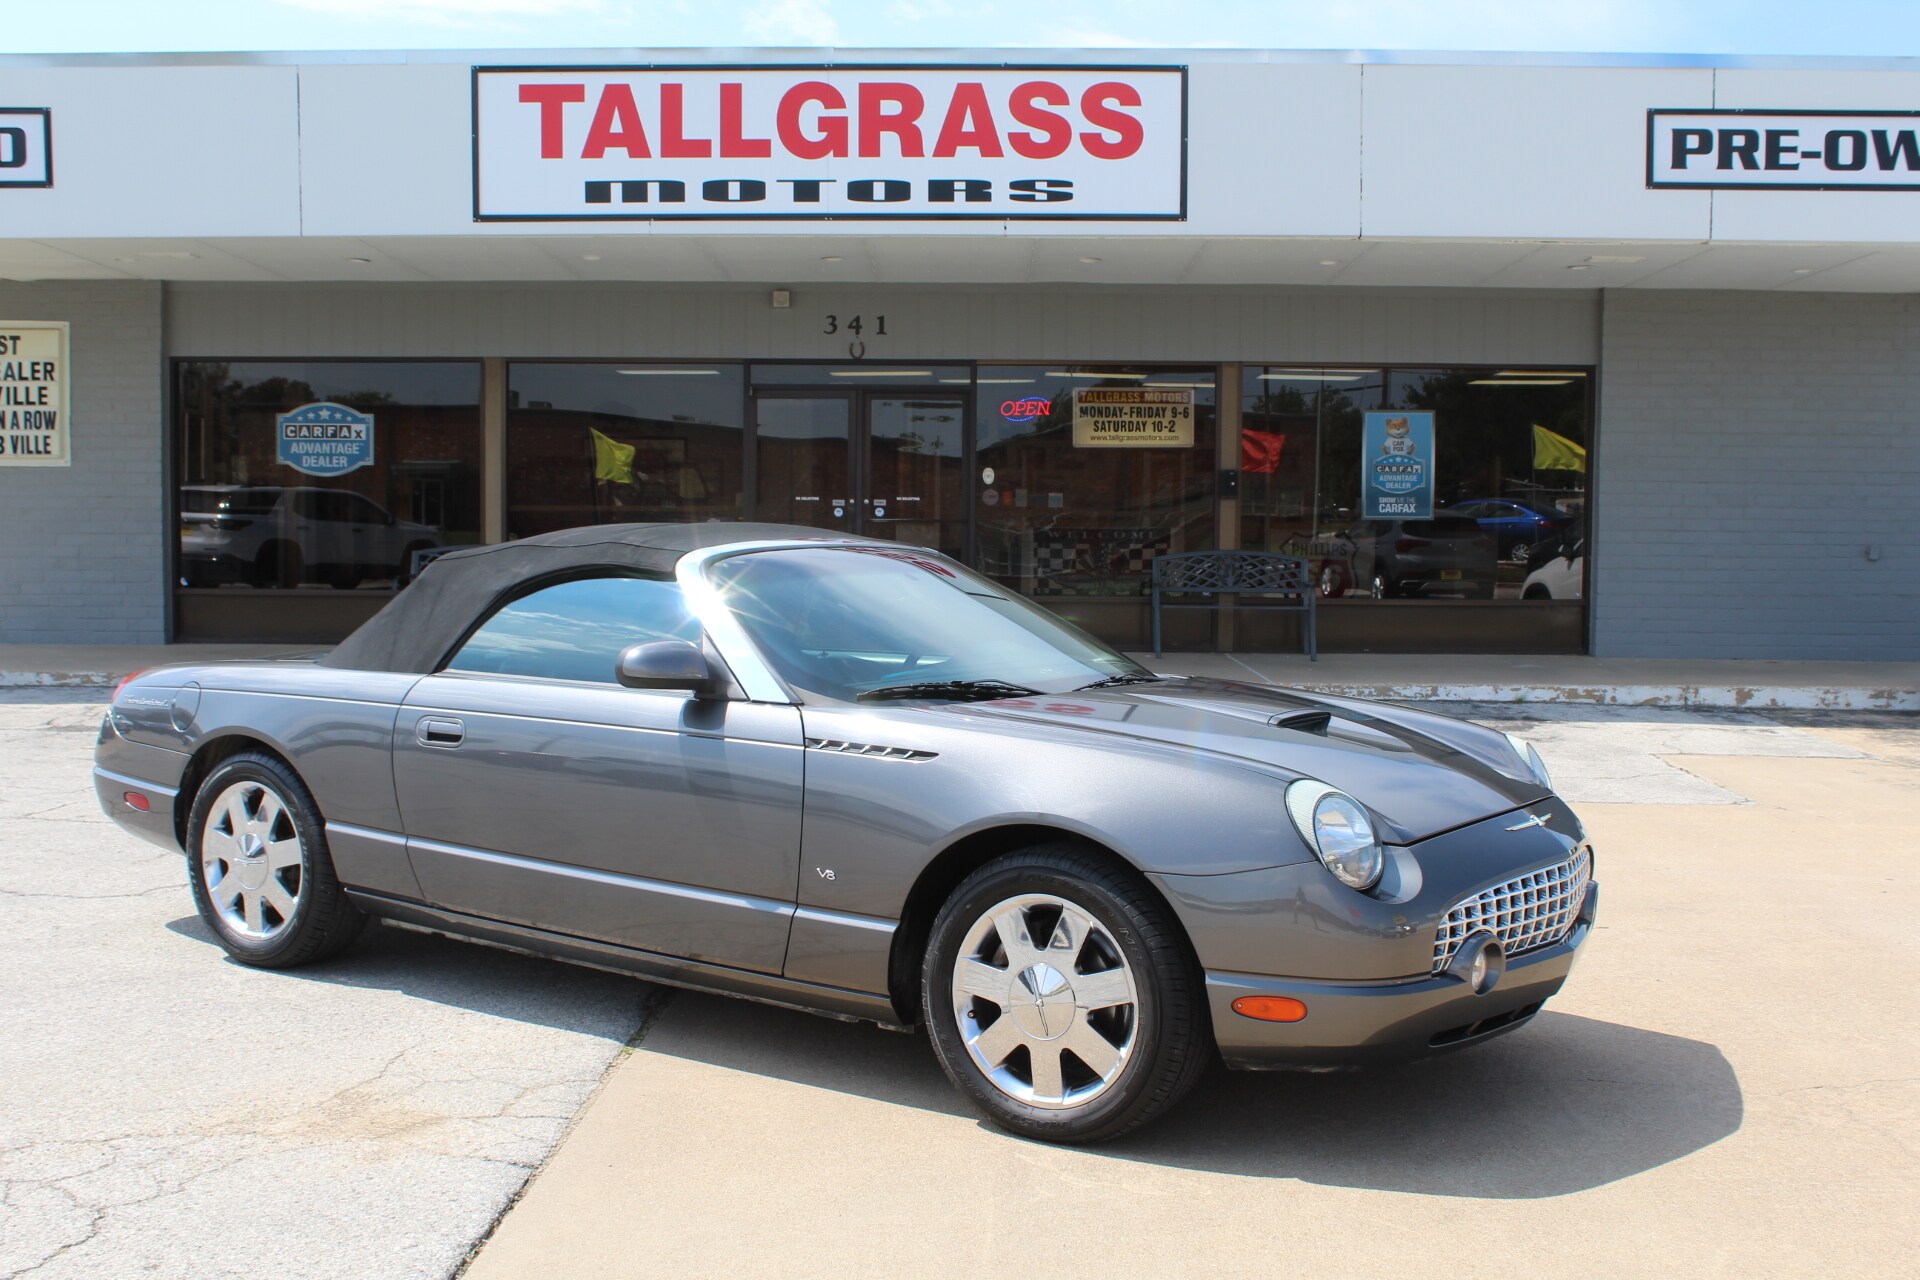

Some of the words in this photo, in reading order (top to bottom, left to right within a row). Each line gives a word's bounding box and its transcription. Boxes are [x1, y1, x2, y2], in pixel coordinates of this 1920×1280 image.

[518, 81, 1144, 160] TALLGRASS
[823, 314, 888, 335] 341
[1081, 392, 1141, 403] TALLGRASS
[1144, 392, 1189, 403] MOTORS
[1000, 401, 1050, 416] OPEN
[1171, 406, 1190, 419] 9-6
[10, 410, 20, 430] A
[24, 410, 57, 430] ROW
[1093, 420, 1147, 433] SATURDAY
[1151, 420, 1176, 433] 10-2
[284, 424, 365, 439] CARFAX
[10, 435, 51, 455] VILLE
[1090, 434, 1180, 443] www.tallgrassmotors.com
[290, 442, 360, 454] ADVANTAGE
[302, 455, 348, 467] DEALER
[1376, 465, 1421, 474] CARFAX
[1379, 503, 1416, 513] CARFAX
[1291, 542, 1348, 557] PHILLIPS
